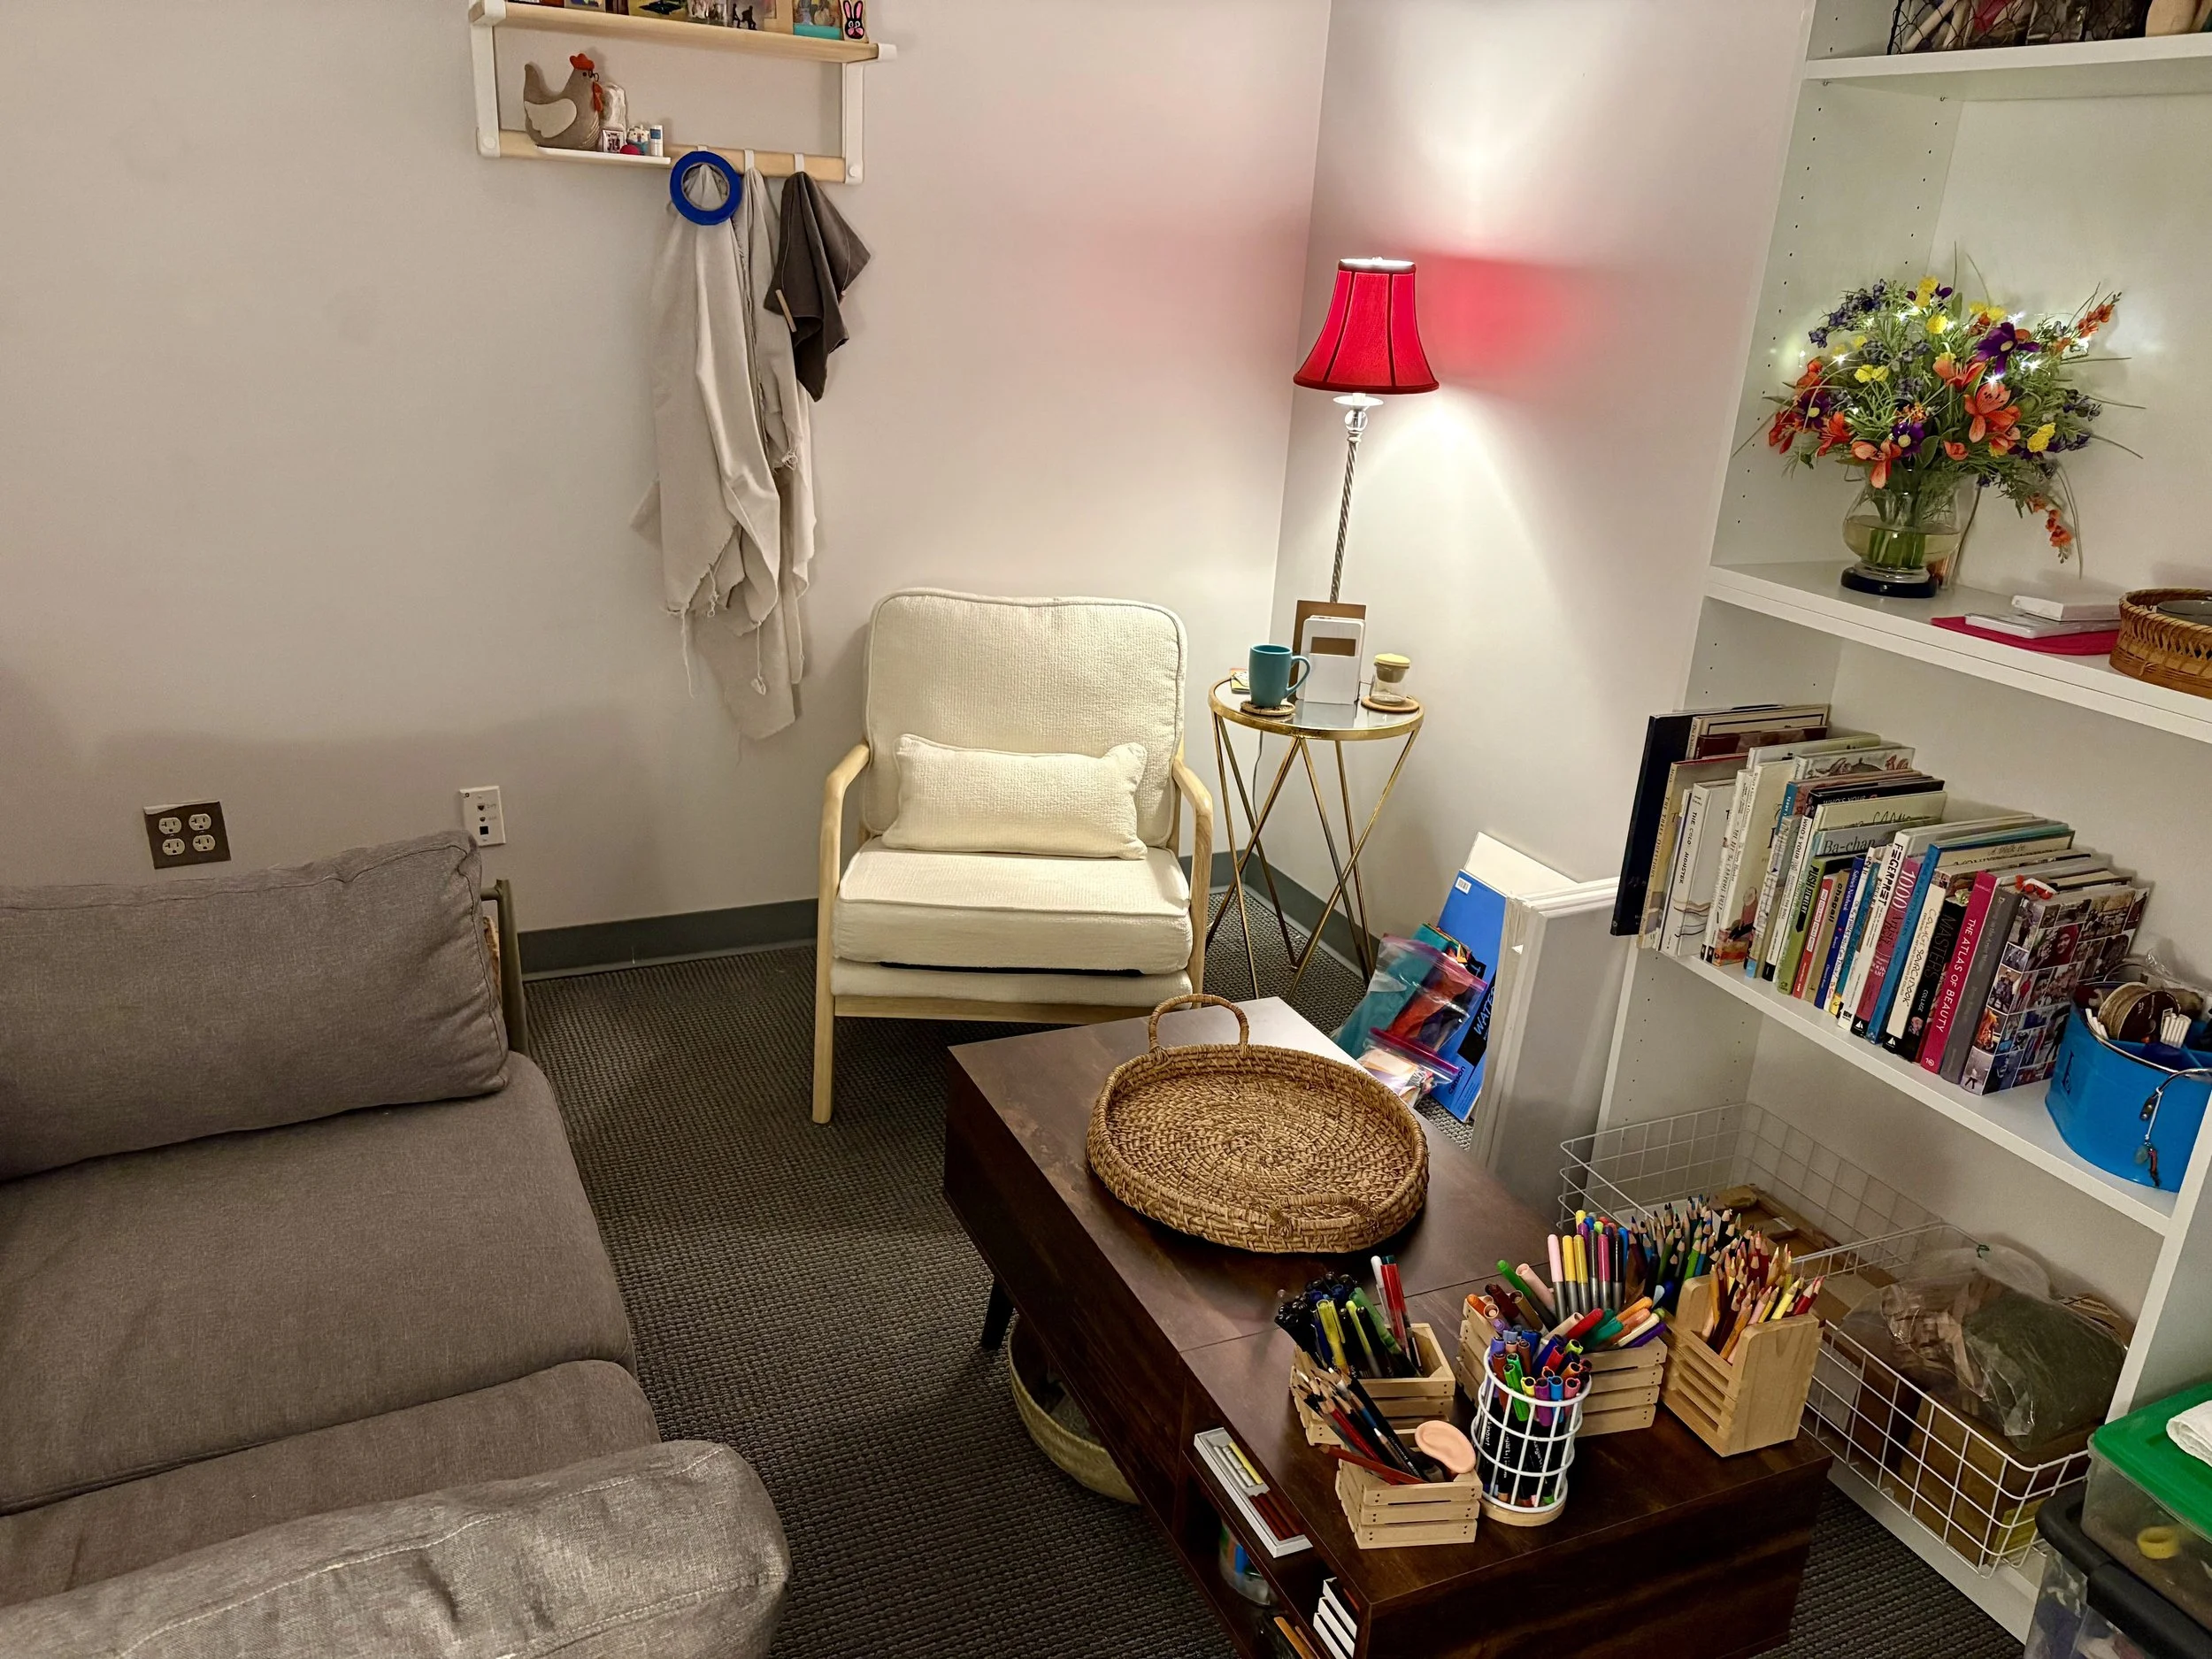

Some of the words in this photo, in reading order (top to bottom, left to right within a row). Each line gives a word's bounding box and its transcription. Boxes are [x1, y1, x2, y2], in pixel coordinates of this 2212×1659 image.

[1798, 818, 1808, 840] WHO'S
[1793, 841, 1802, 859] YOUR
[1824, 836, 1876, 854] Ba-chan
[1678, 851, 1689, 884] MONSTER
[1805, 864, 1819, 887] PUSH
[1800, 887, 1811, 913] JEWELRY
[1842, 887, 1854, 911] Notebook
[1890, 867, 1916, 910] 1000
[1826, 882, 1844, 923] chagall
[1964, 918, 1976, 935] THE
[1924, 912, 1956, 980] MASTERS
[1953, 936, 1970, 972] ATLAS
[1947, 973, 1959, 987] OF
[1916, 989, 1928, 1012] COLLAGE
[1936, 987, 1955, 1033] BEAUTY
